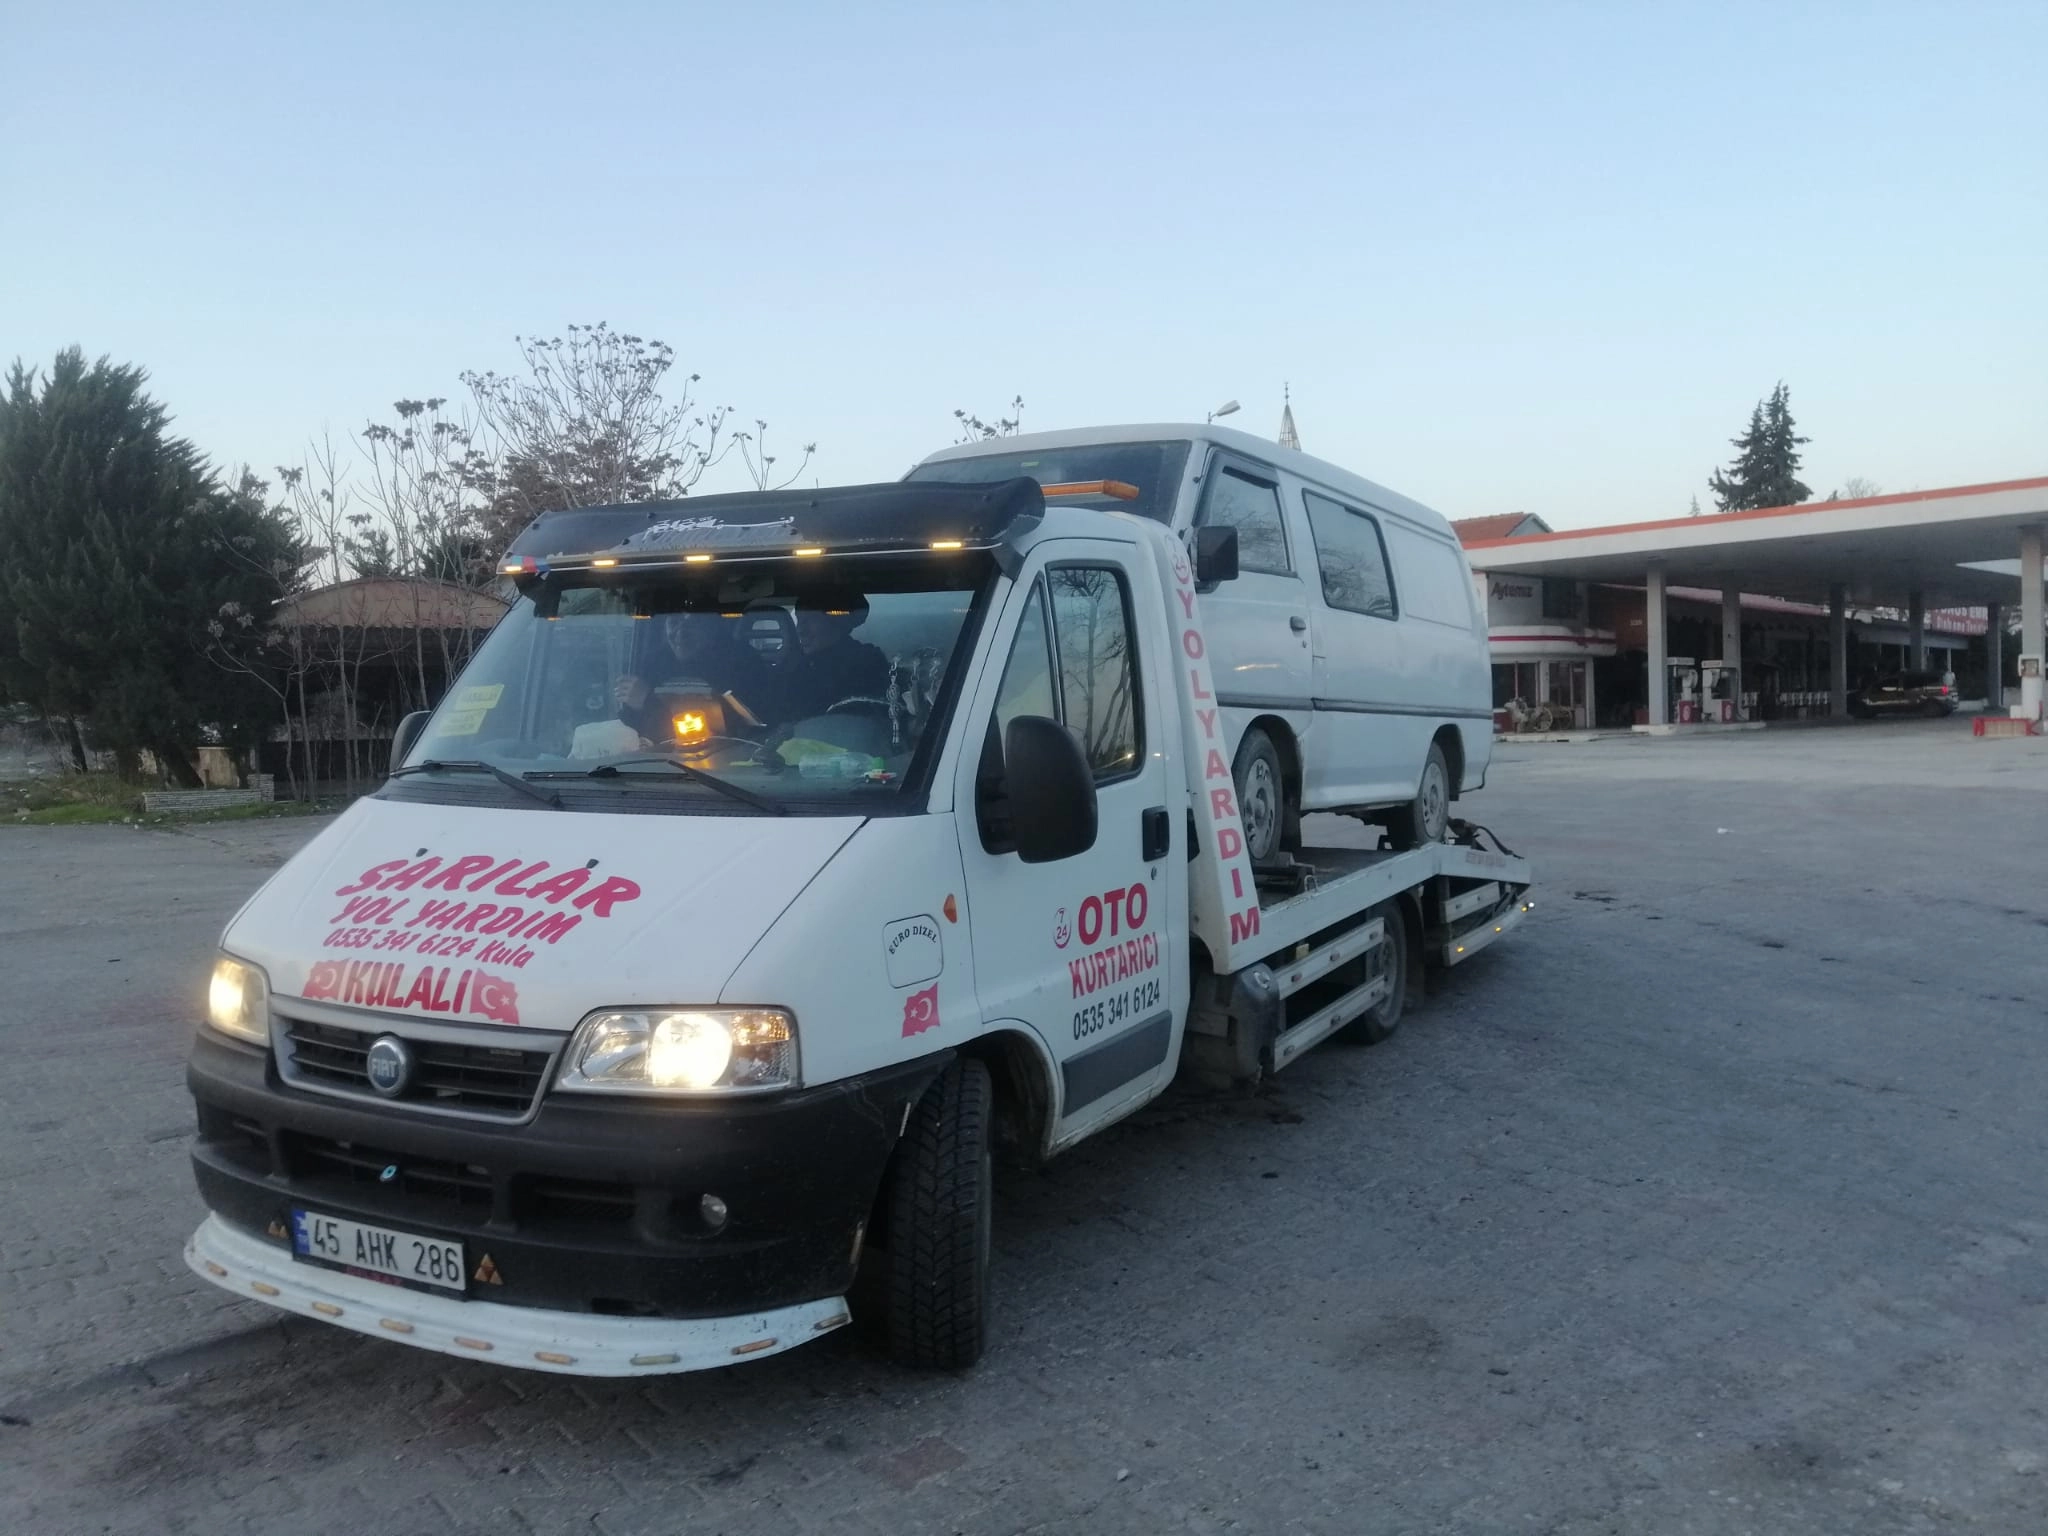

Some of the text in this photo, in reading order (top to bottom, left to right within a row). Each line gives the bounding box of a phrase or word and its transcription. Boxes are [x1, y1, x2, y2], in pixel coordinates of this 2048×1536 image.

[336, 855, 641, 917] SARILAR
[330, 896, 582, 944] YOL YARDIM
[1056, 923, 1067, 939] 24
[1078, 882, 1148, 945] OTO
[323, 928, 535, 968] 0535 341 6124 Kula
[888, 928, 910, 954] EURO
[1068, 931, 1159, 1000] KURTARICI
[343, 960, 473, 1013] KULALI
[1073, 978, 1160, 1040] 0535 341 6124
[371, 1058, 397, 1078] FIAT
[314, 1218, 340, 1255] 45
[355, 1228, 399, 1272] AHK
[412, 1241, 460, 1282] 286
